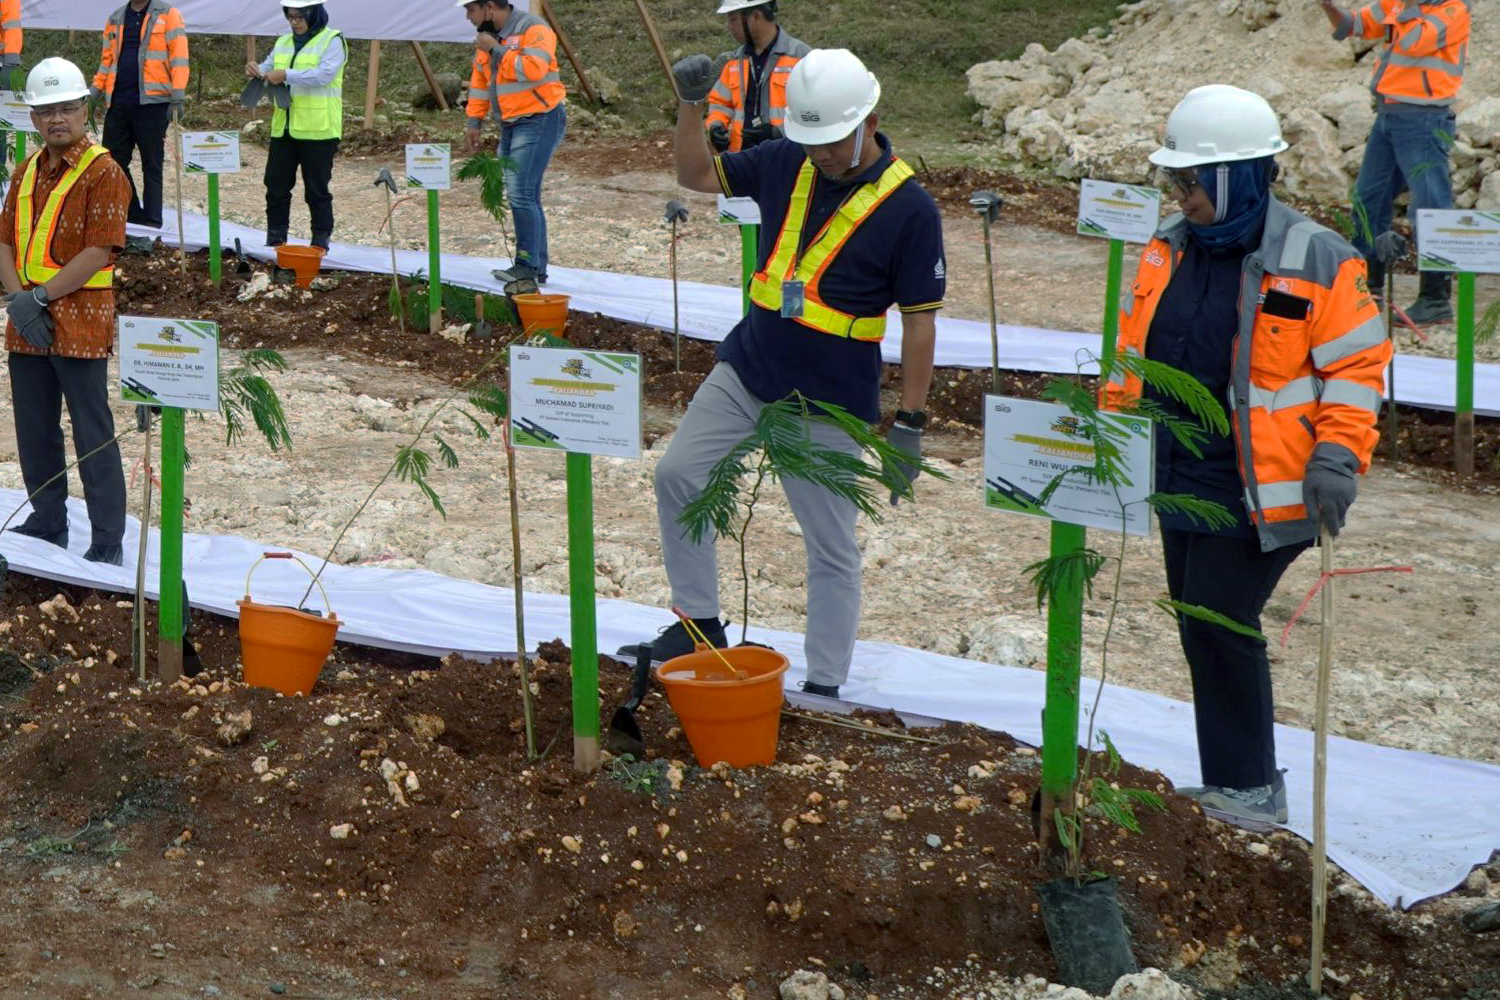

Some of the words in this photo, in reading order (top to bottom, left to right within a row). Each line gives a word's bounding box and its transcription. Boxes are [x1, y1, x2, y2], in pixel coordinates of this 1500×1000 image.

[801, 114, 820, 122] SIG
[535, 398, 577, 408] MUCHAMAD
[578, 401, 614, 411] SUPRIYADI
[995, 405, 1012, 413] SIG
[1028, 459, 1049, 468] RENI
